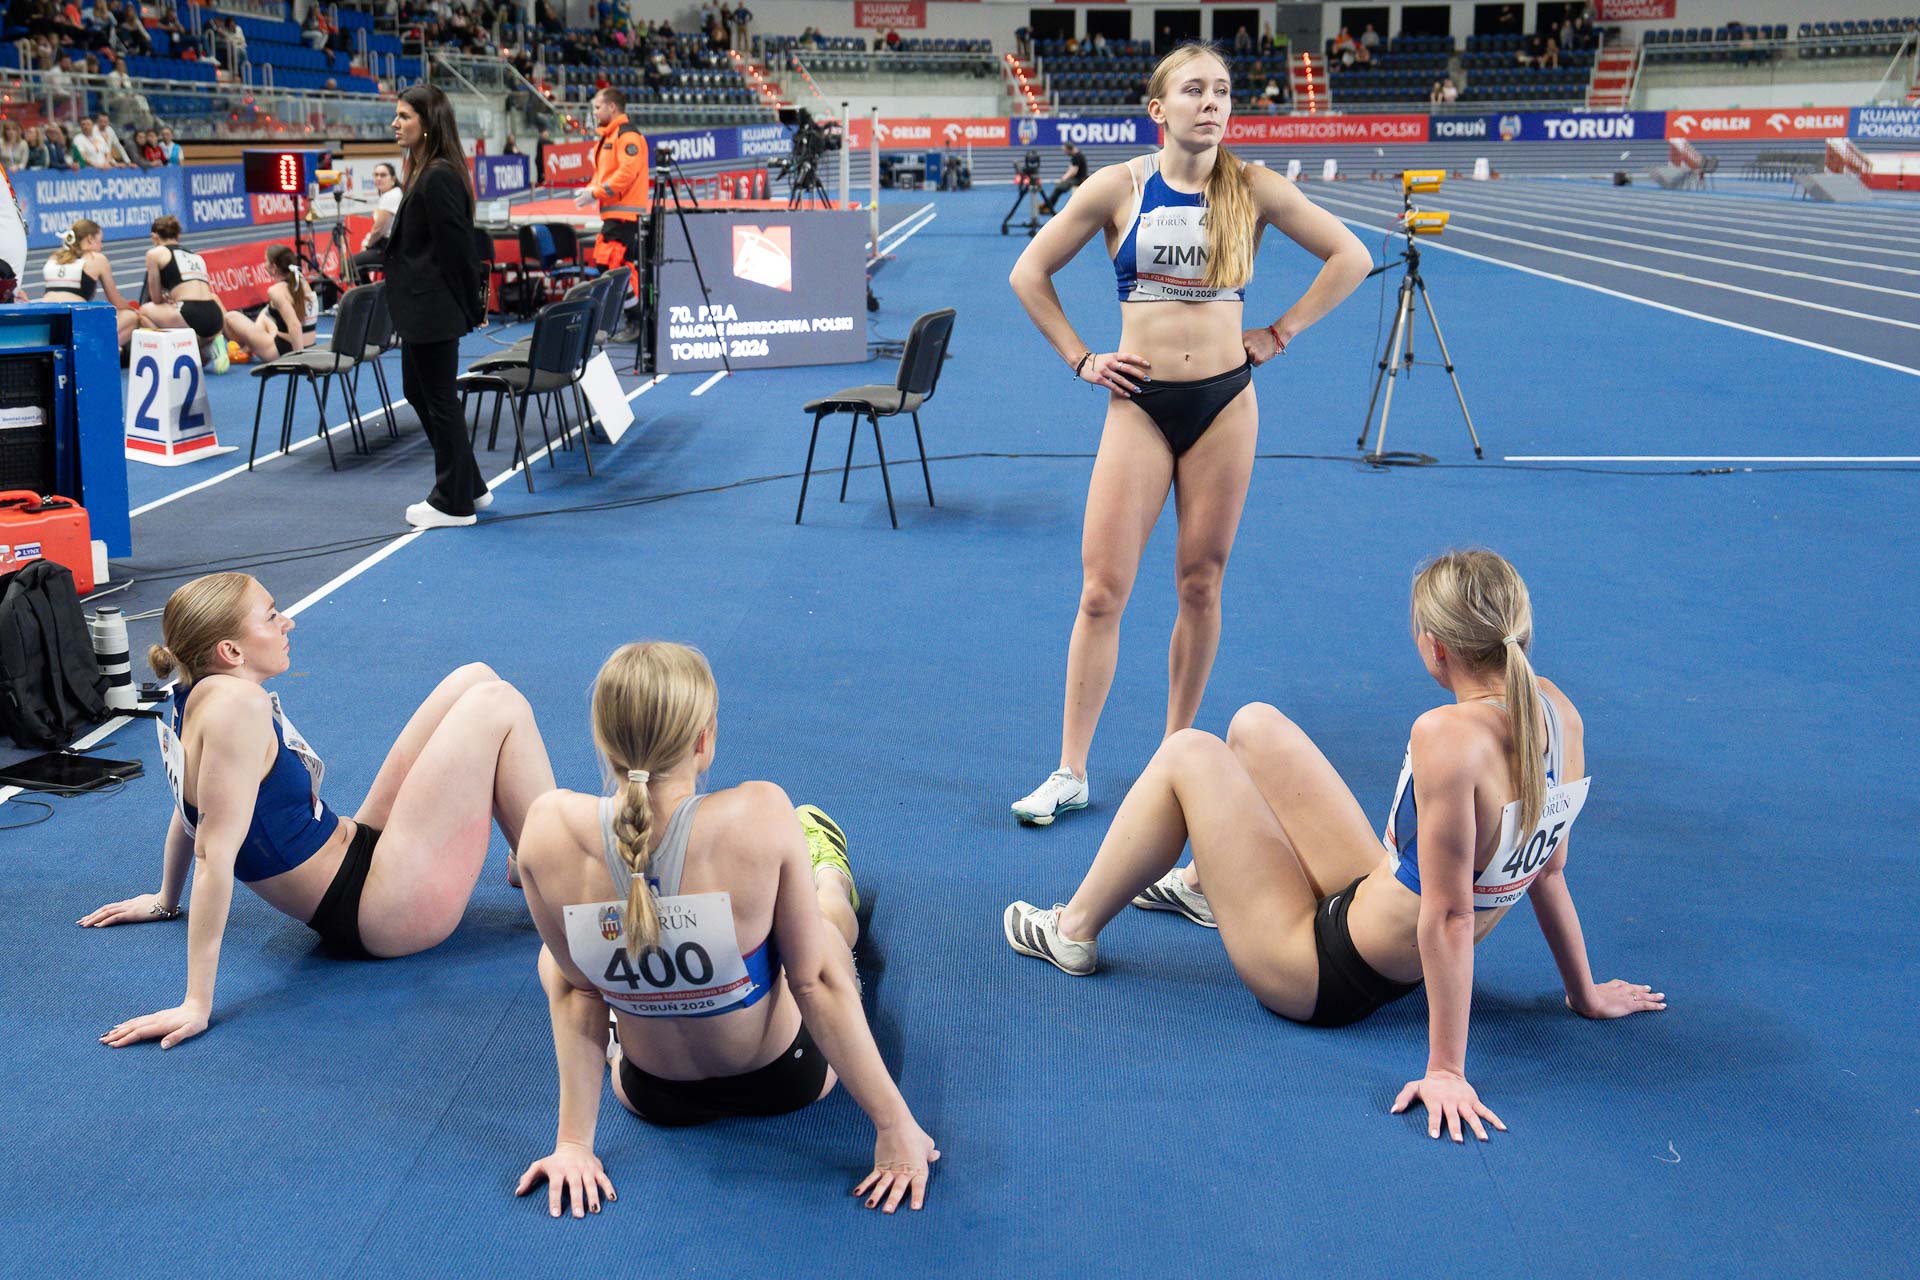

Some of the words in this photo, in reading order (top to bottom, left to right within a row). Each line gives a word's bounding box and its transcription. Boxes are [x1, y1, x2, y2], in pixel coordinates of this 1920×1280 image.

[1543, 113, 1635, 139] TORUŃ
[1701, 117, 1750, 131] ORLEN
[1794, 115, 1845, 129] ORLEN
[1860, 109, 1920, 124] KUJAWY
[741, 126, 784, 142] KUJAWY
[892, 126, 932, 139] ORLEN
[964, 125, 1006, 139] ORLEN
[1056, 119, 1137, 143] TORUŃ
[1226, 123, 1266, 139] LOWE
[1269, 123, 1366, 139] MISTRZOSTWA
[1370, 122, 1421, 137] POLSKI
[1435, 118, 1487, 137] TORUŃ
[1858, 122, 1920, 138] POMORZ
[742, 138, 792, 156] POMORZE
[558, 153, 583, 171] ORLEN
[191, 172, 236, 196] KUJAWY
[493, 159, 526, 191] TORUŃ
[36, 176, 162, 204] KUJAWSKO-POMORSKI
[192, 197, 247, 223] POMORZE
[257, 194, 305, 216] POMORE
[1152, 245, 1210, 267] ZIMN
[207, 265, 252, 294] HALOWE
[1161, 286, 1194, 298] TORUŃ
[1195, 290, 1217, 298] 2026
[669, 306, 694, 324] 70.
[699, 304, 738, 322] PZLA
[669, 324, 725, 339] HALOWE
[726, 319, 811, 337] MISTRZOSTWA
[812, 317, 854, 332] POLSKI
[670, 337, 728, 361] TORUŃ
[730, 339, 770, 358] 2026
[135, 355, 160, 432] 2
[172, 354, 205, 431] 2
[22, 548, 40, 556] LYNX
[1542, 796, 1571, 818] ORUŃ
[1501, 820, 1566, 879] 405
[658, 909, 698, 930] RUŃ
[603, 941, 714, 990] 400
[664, 989, 718, 1000] Mistrzostwa
[718, 979, 745, 994] Polski
[631, 1001, 678, 1012] TORUŃ
[681, 999, 715, 1011] 2026
